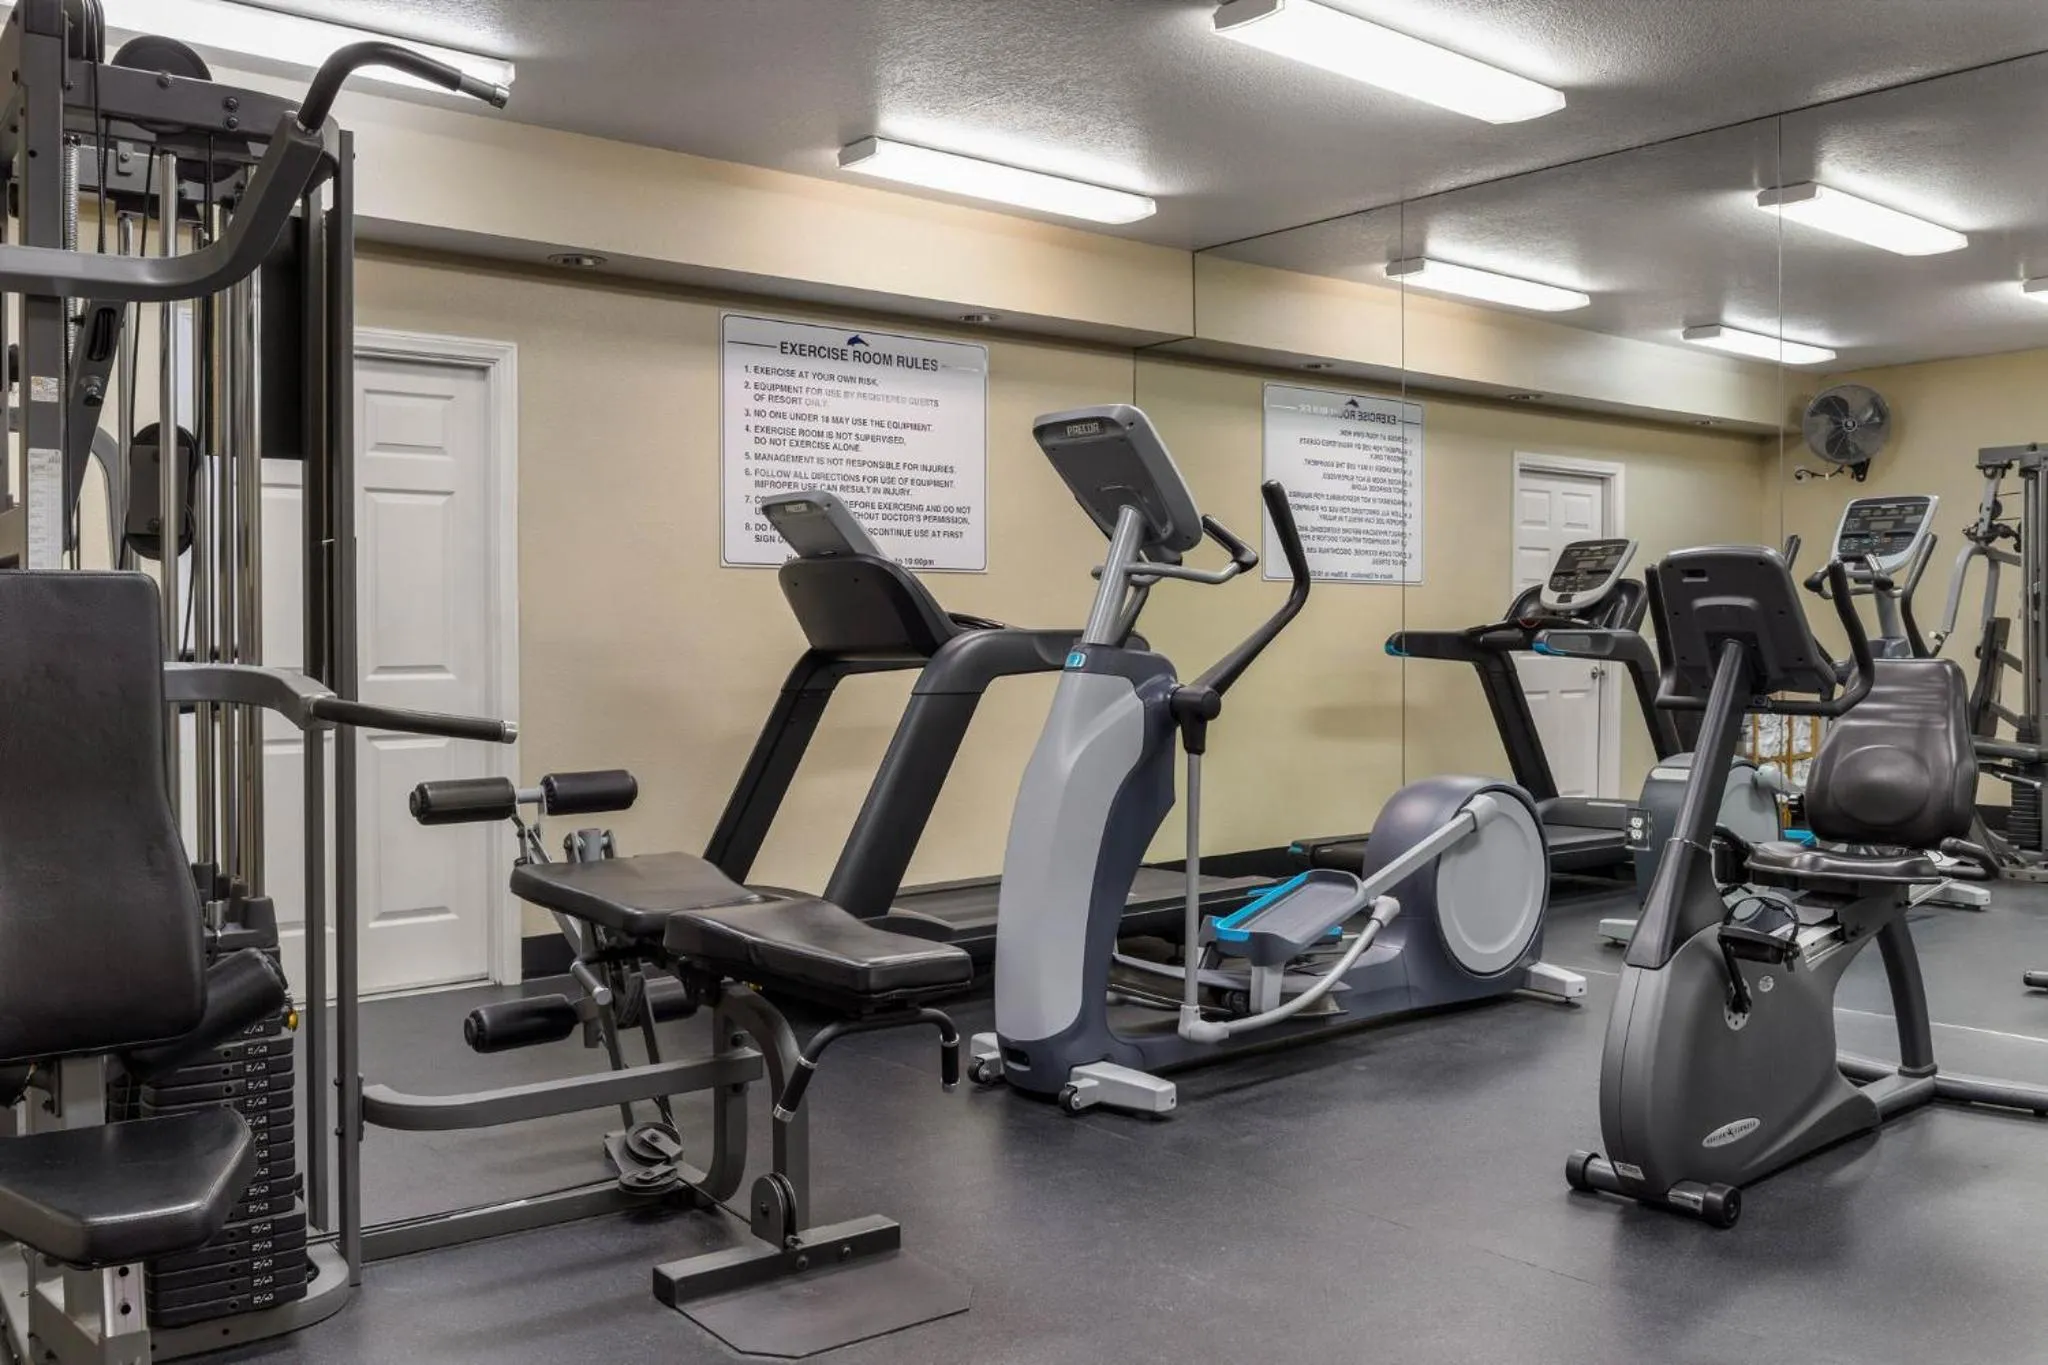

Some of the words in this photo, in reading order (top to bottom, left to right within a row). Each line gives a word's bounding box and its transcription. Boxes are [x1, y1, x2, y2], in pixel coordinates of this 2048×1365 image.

[780, 341, 849, 361] EXERCISE
[852, 350, 893, 367] ROOM
[896, 355, 939, 372] RULES
[753, 365, 796, 377] EXERCISE
[799, 371, 809, 379] AT
[812, 372, 835, 381] YOUR
[837, 374, 857, 384] OWN
[754, 382, 803, 394] EQUIPMENT
[805, 387, 823, 396] FOR
[753, 393, 766, 402] OF
[768, 394, 803, 405] RESORT
[754, 409, 767, 418] NO
[768, 411, 787, 420] ONE
[789, 412, 819, 422] UNDER
[831, 416, 850, 425] MAY
[852, 418, 868, 426] USE
[870, 419, 886, 428] THE
[754, 425, 797, 437] EXERCISE
[798, 429, 824, 438] ROOM
[826, 430, 834, 439] IS
[836, 431, 853, 441] NOT
[1066, 422, 1101, 437] PRECOR
[754, 436, 767, 445] DO
[769, 438, 787, 447] NOT
[789, 439, 830, 450] EXERCISE
[754, 452, 814, 465] MANAGEMENT
[817, 456, 825, 465] IS
[827, 457, 843, 466] NOT
[846, 458, 901, 471] RESPONSIBLE
[902, 462, 919, 471] FOR
[754, 468, 791, 478] FOLLOW
[793, 471, 809, 480] ALL
[811, 472, 861, 482] DIRECTIONS
[862, 475, 879, 484] FOR
[880, 476, 896, 485] USE
[898, 477, 909, 486] OF
[754, 479, 800, 490] IMPROPER
[801, 482, 817, 491] USE
[820, 483, 838, 492] CAN
[840, 484, 870, 494] RESULT
[872, 486, 881, 494] IN
[845, 500, 877, 510] EFORE
[878, 501, 924, 512] EXERCISING
[925, 504, 942, 513] AND
[943, 505, 955, 514] DO
[956, 506, 971, 514] NOT
[881, 513, 921, 522] DOCTOR'S
[754, 523, 768, 532] DO
[868, 527, 912, 537] SCONTINUE
[914, 529, 929, 538] USE
[931, 530, 941, 538] AT
[942, 530, 963, 539] FIRST
[754, 534, 776, 543] SIGN
